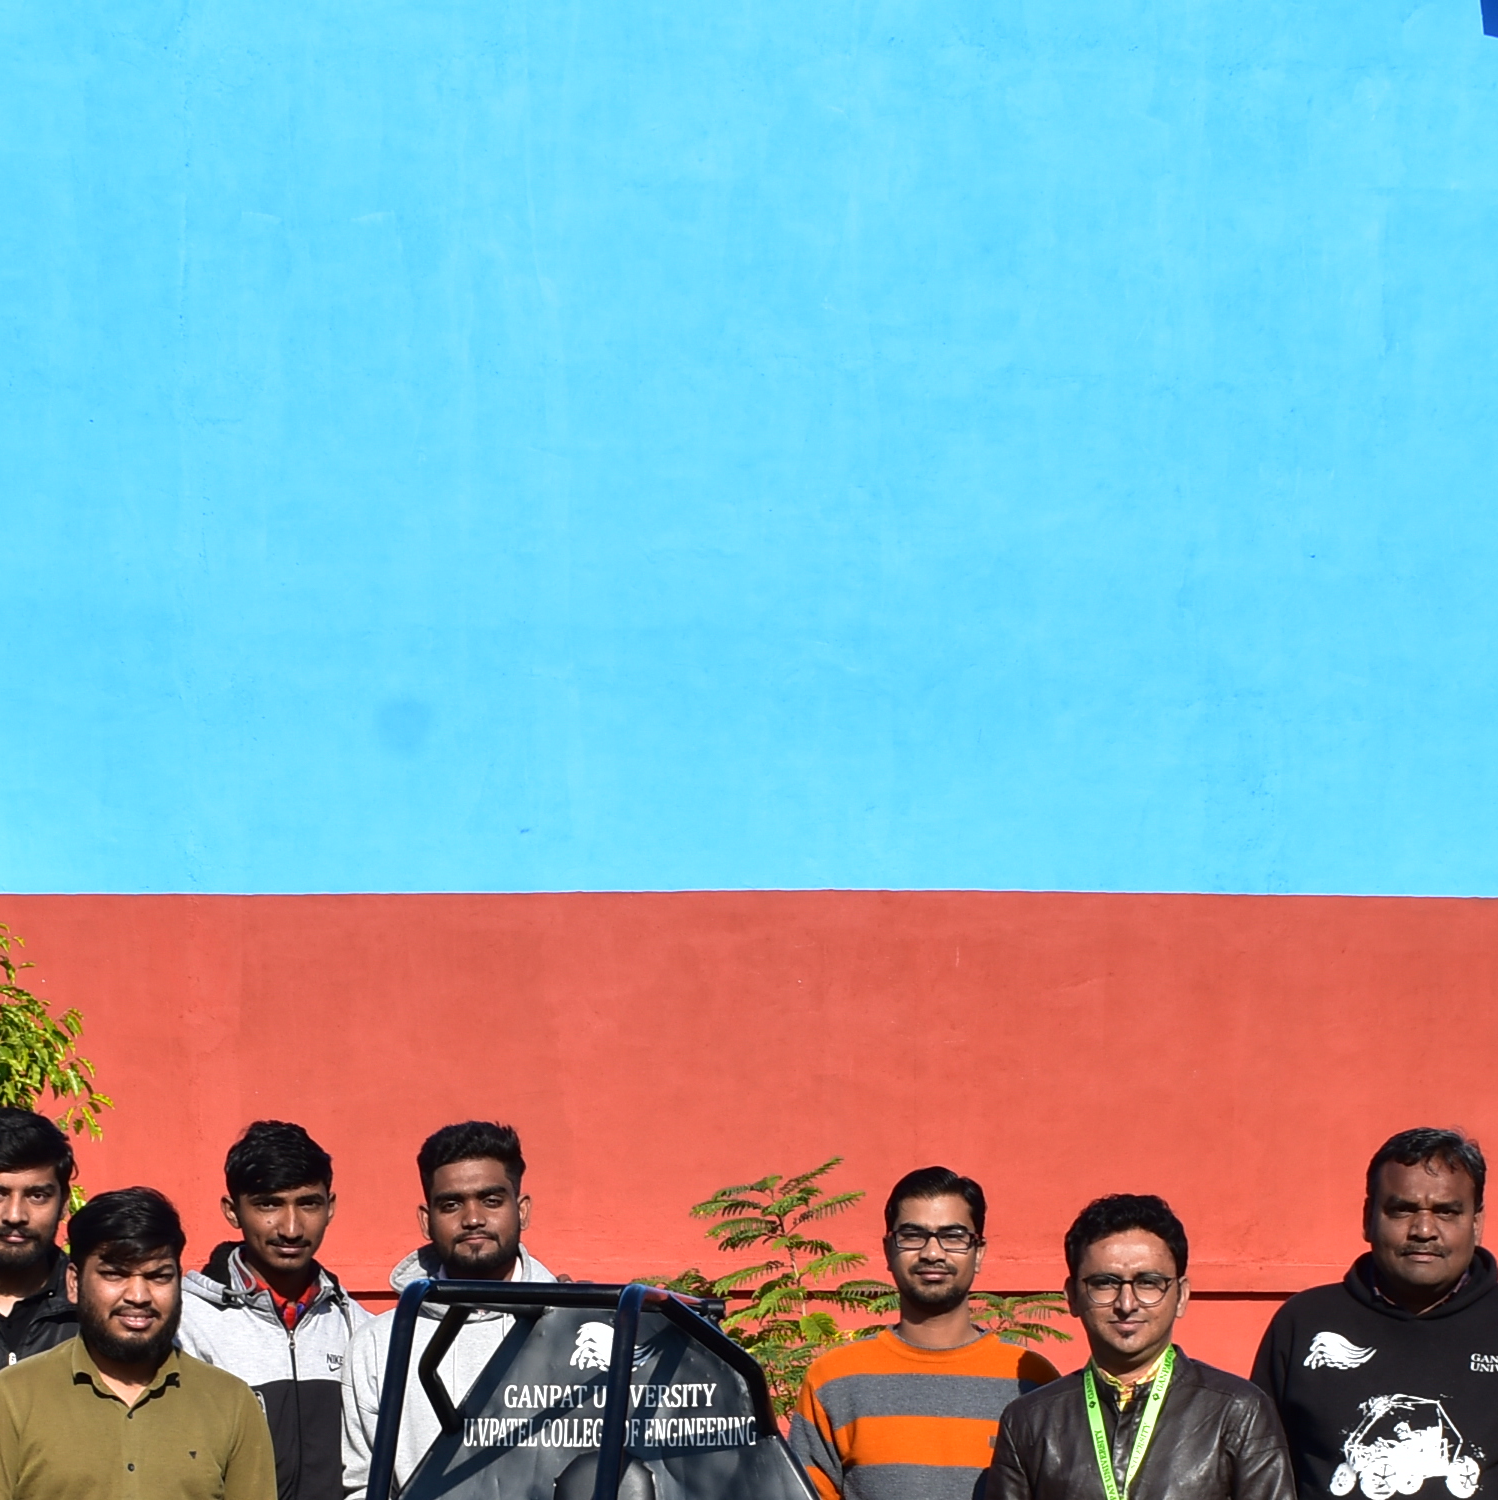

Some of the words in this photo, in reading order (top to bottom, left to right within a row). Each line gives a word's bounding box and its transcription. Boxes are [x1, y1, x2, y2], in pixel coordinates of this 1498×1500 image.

[504, 1384, 588, 1409] GANPAT
[593, 1383, 717, 1409] UVERSITY
[541, 1418, 602, 1447] COLLEG
[644, 1416, 757, 1447] ENGINEERING
[1094, 1430, 1114, 1482] UNIVERSITY
